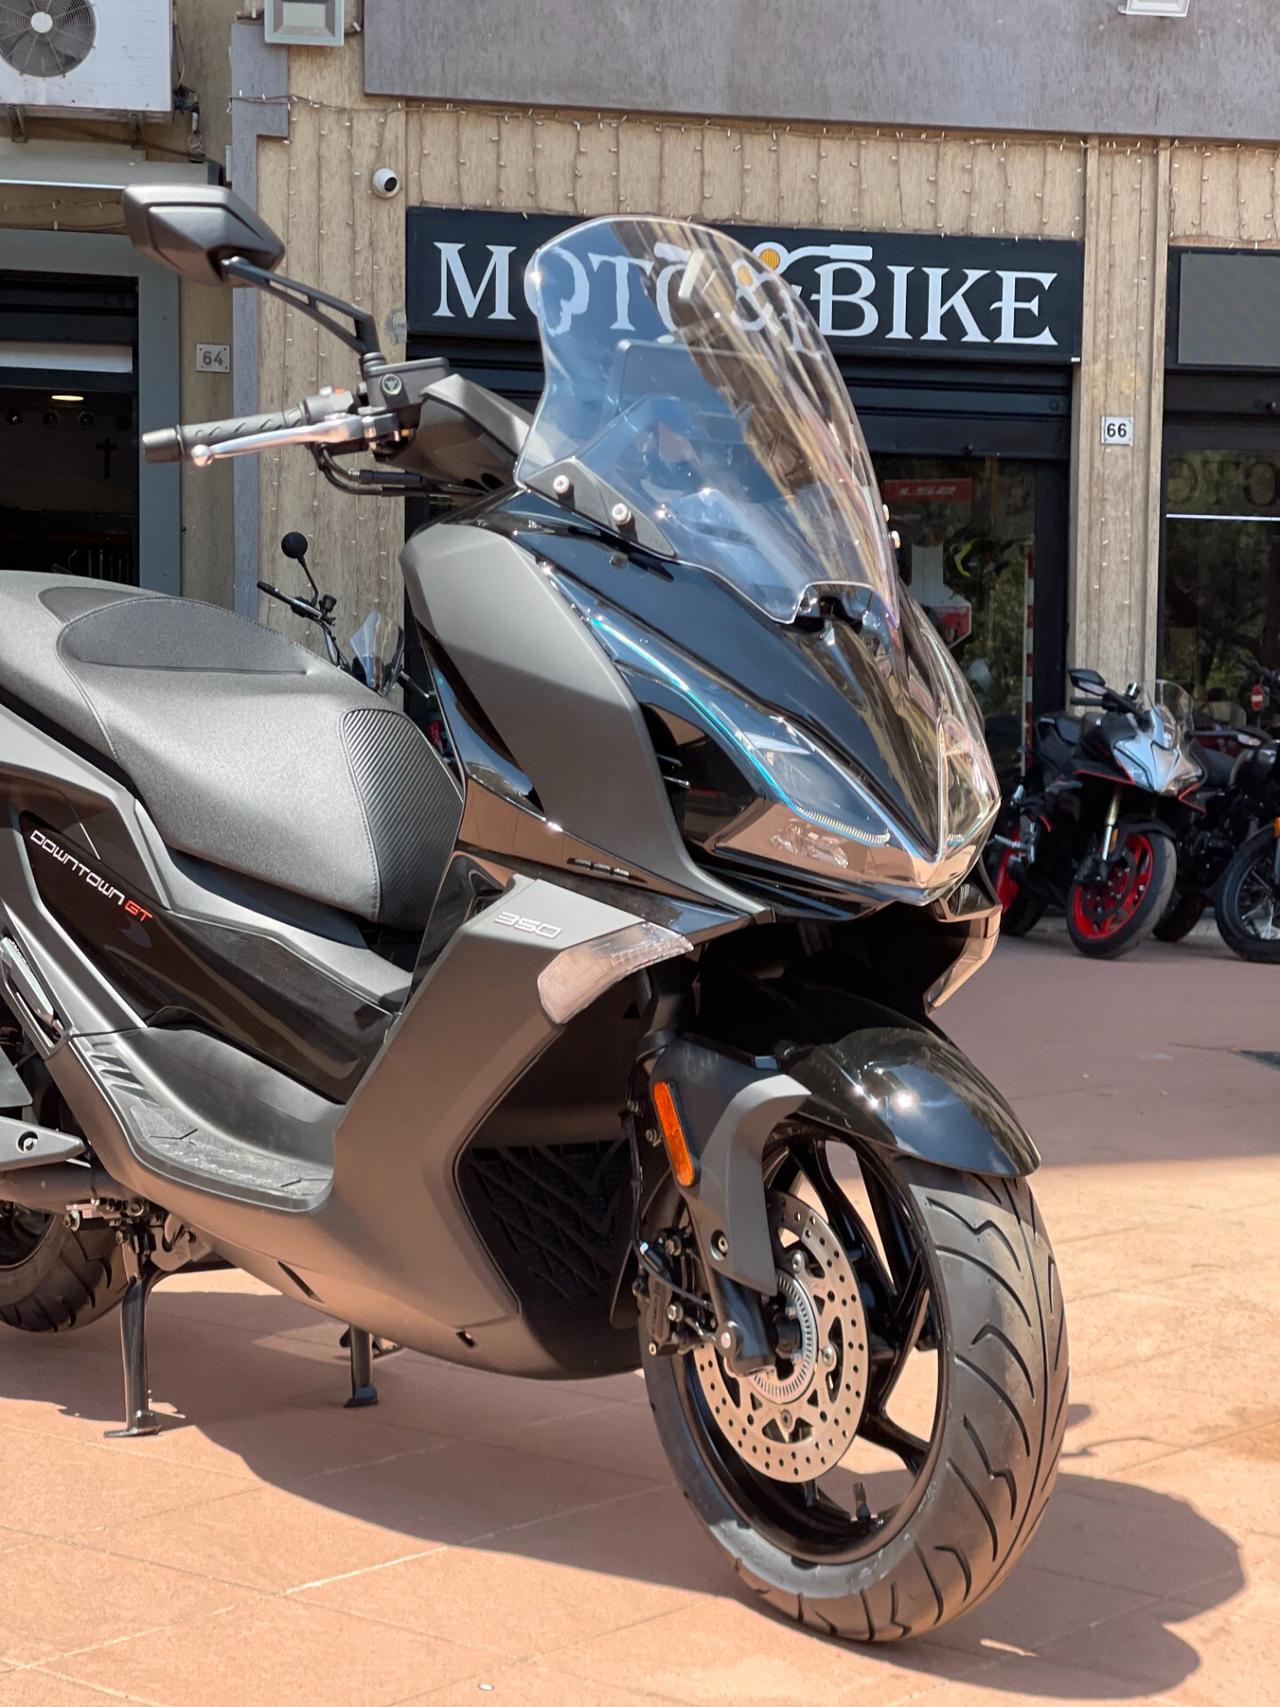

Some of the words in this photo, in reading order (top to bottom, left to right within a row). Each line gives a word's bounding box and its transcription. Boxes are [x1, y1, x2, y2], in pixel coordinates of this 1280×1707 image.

[202, 350, 224, 366] 64
[1106, 422, 1127, 438] 66
[30, 829, 125, 905] DOWNTOWN
[124, 900, 153, 921] GT
[494, 911, 562, 939] 350
